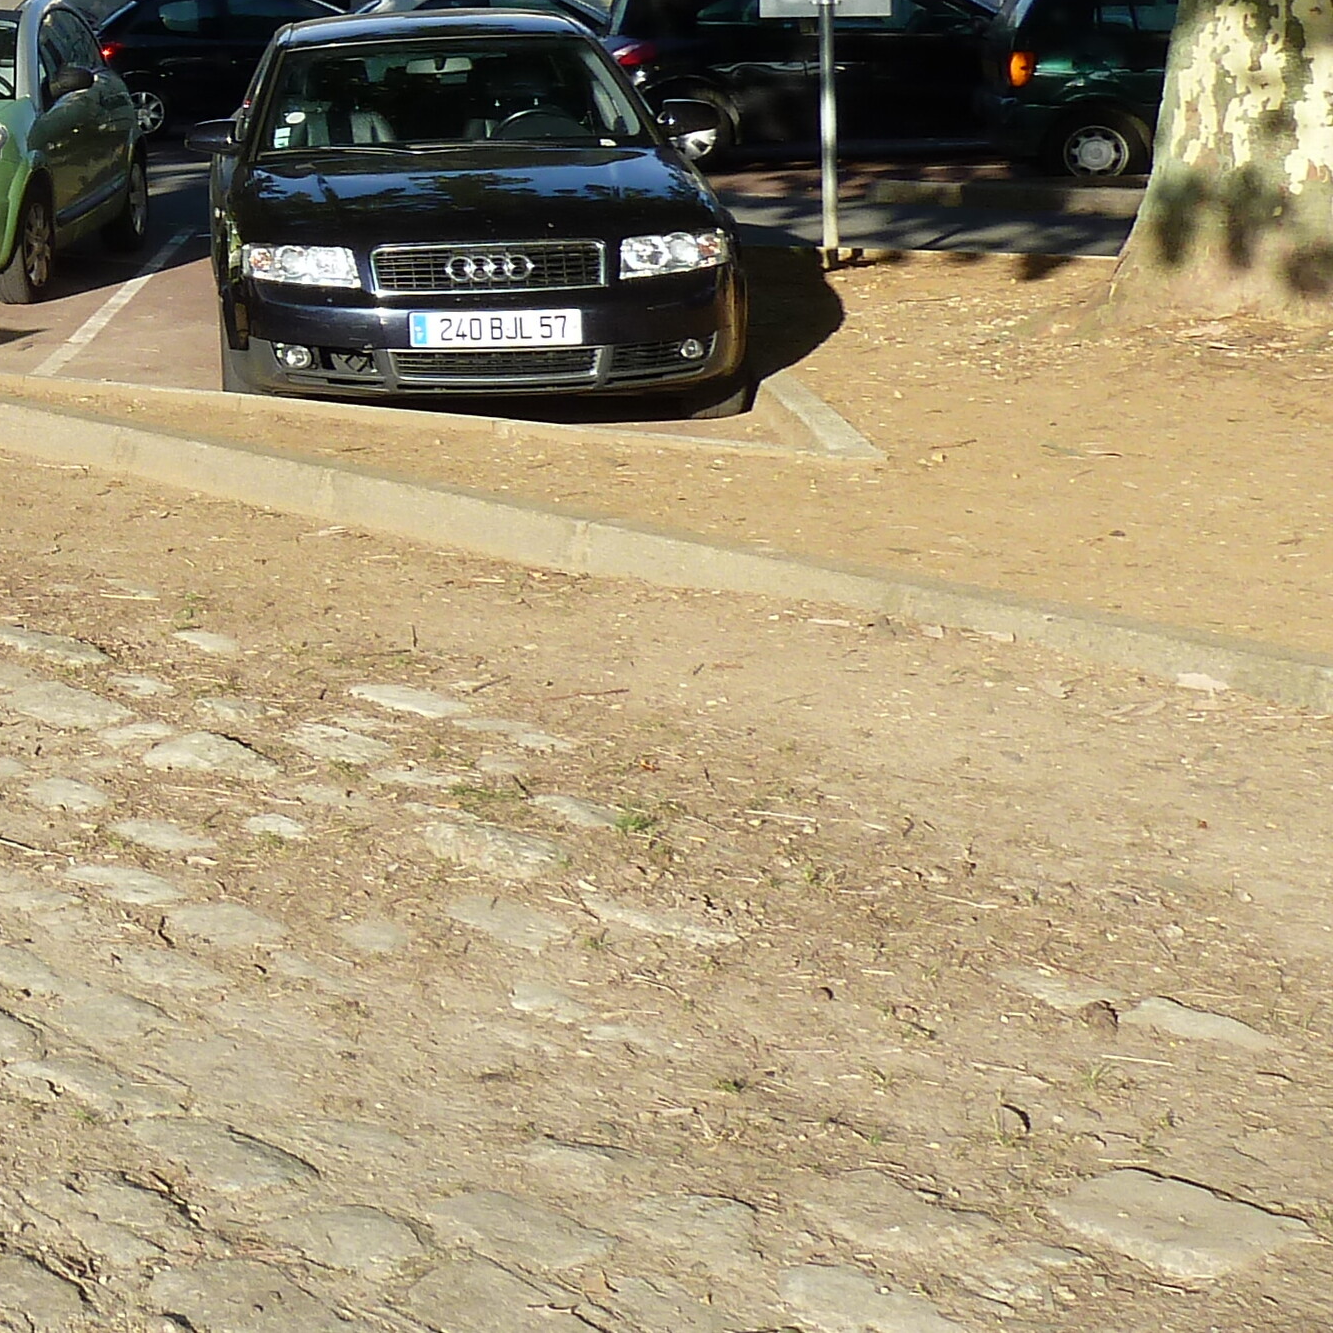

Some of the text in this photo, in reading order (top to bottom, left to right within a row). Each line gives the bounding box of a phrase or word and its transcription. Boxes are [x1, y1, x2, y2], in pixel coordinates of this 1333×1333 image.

[440, 315, 567, 341] 240 BJL 57
